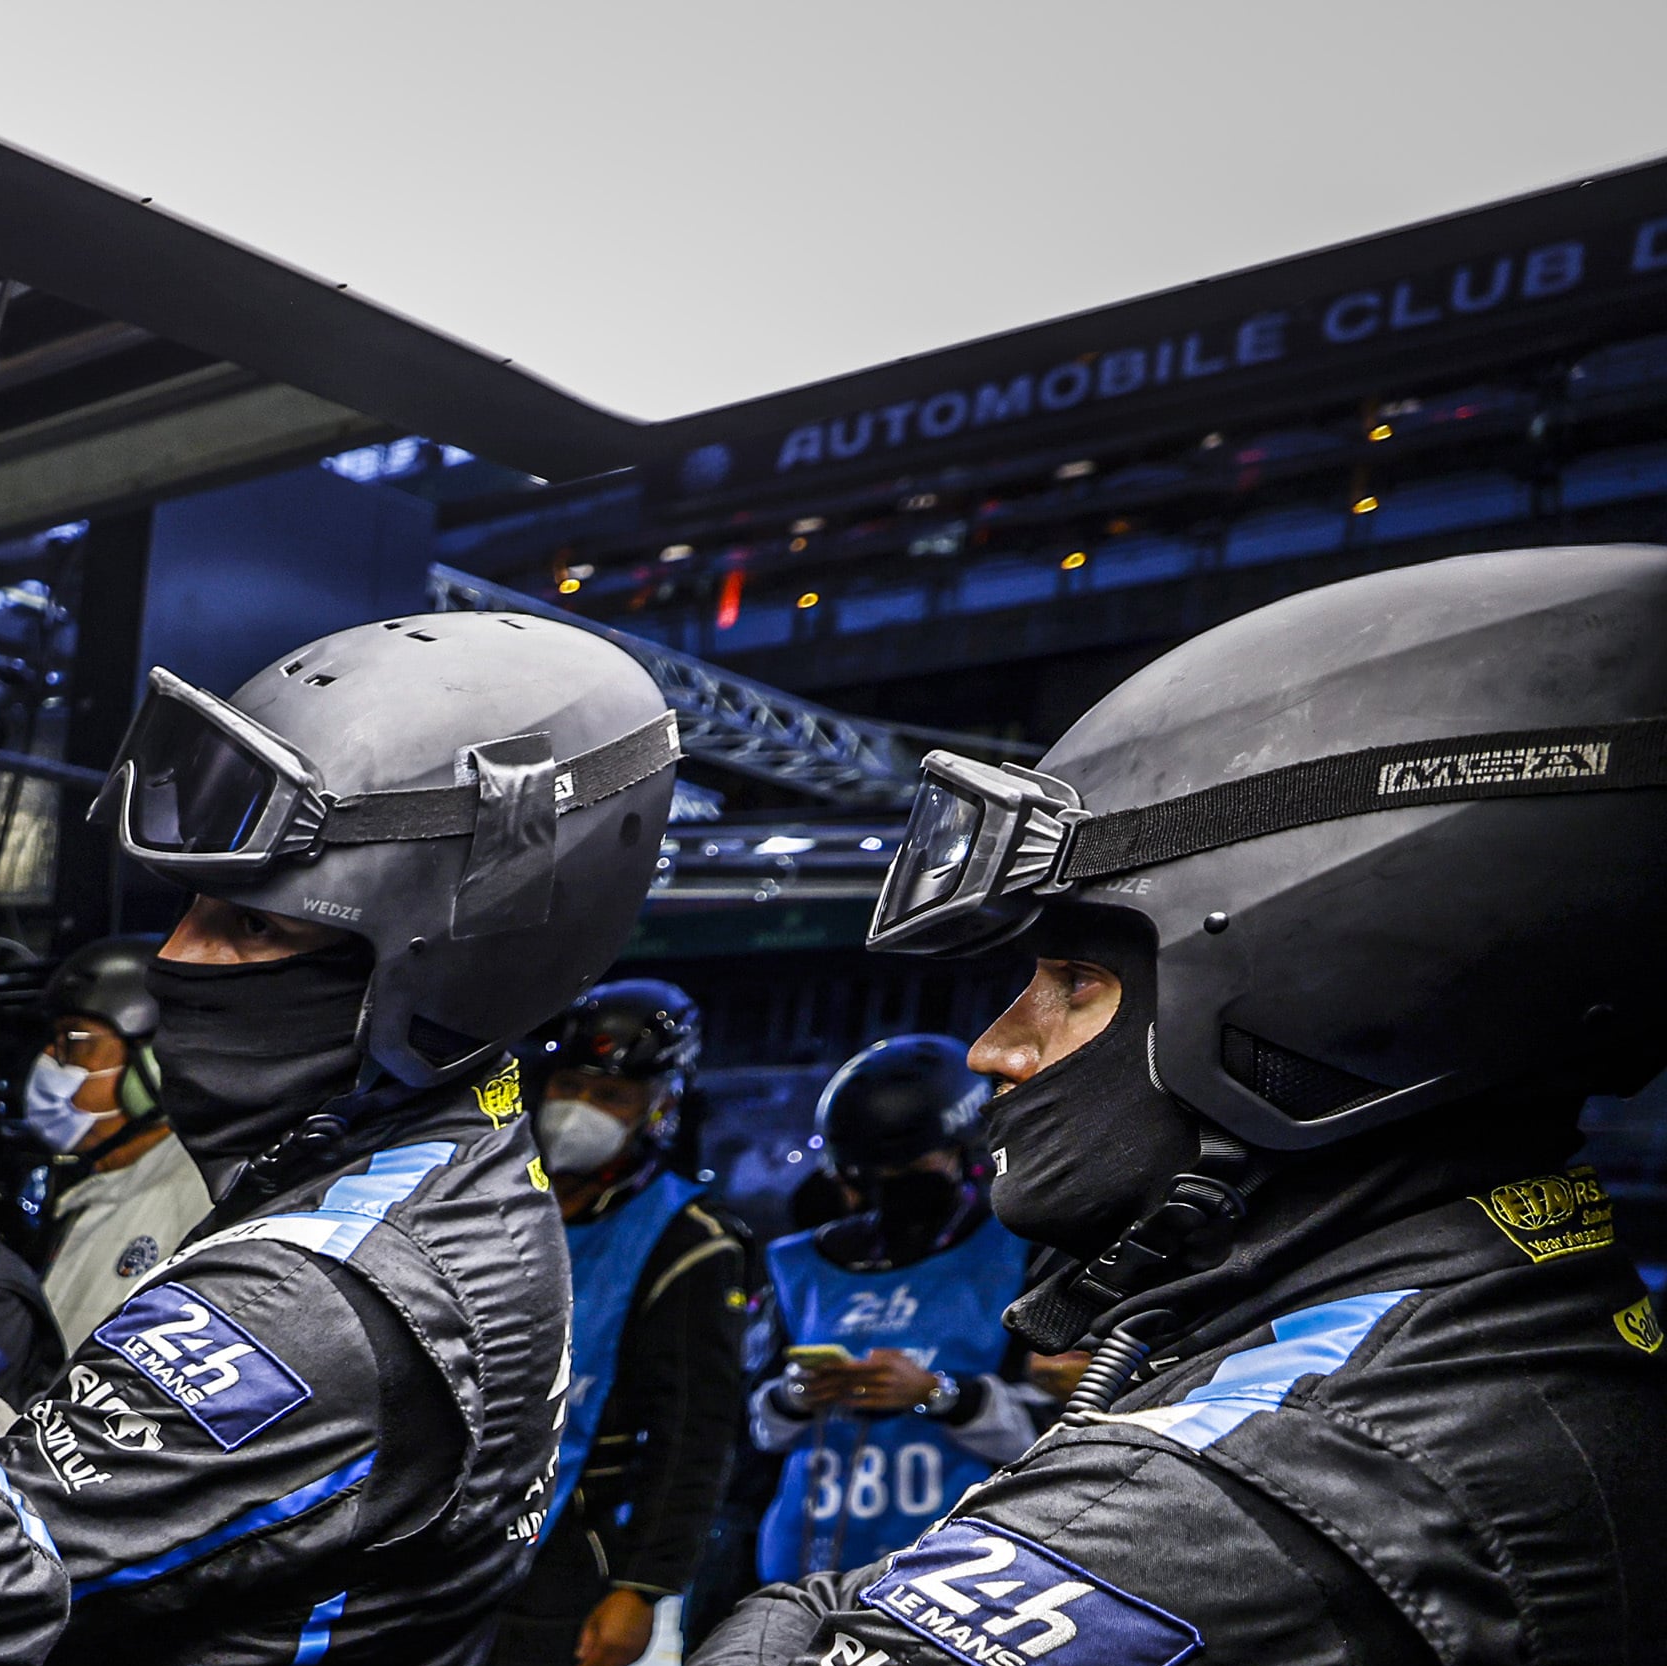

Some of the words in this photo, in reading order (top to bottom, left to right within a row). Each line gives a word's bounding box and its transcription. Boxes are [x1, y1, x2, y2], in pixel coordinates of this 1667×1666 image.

[774, 311, 1286, 473] AUTOMOBILE
[1322, 241, 1586, 344] CLUB
[303, 897, 363, 922] WEDZE
[122, 1336, 148, 1364] LE
[140, 1350, 205, 1406] MANS
[137, 1303, 256, 1396] 24h
[886, 1584, 921, 1619] LE
[908, 1536, 1096, 1658] 24h
